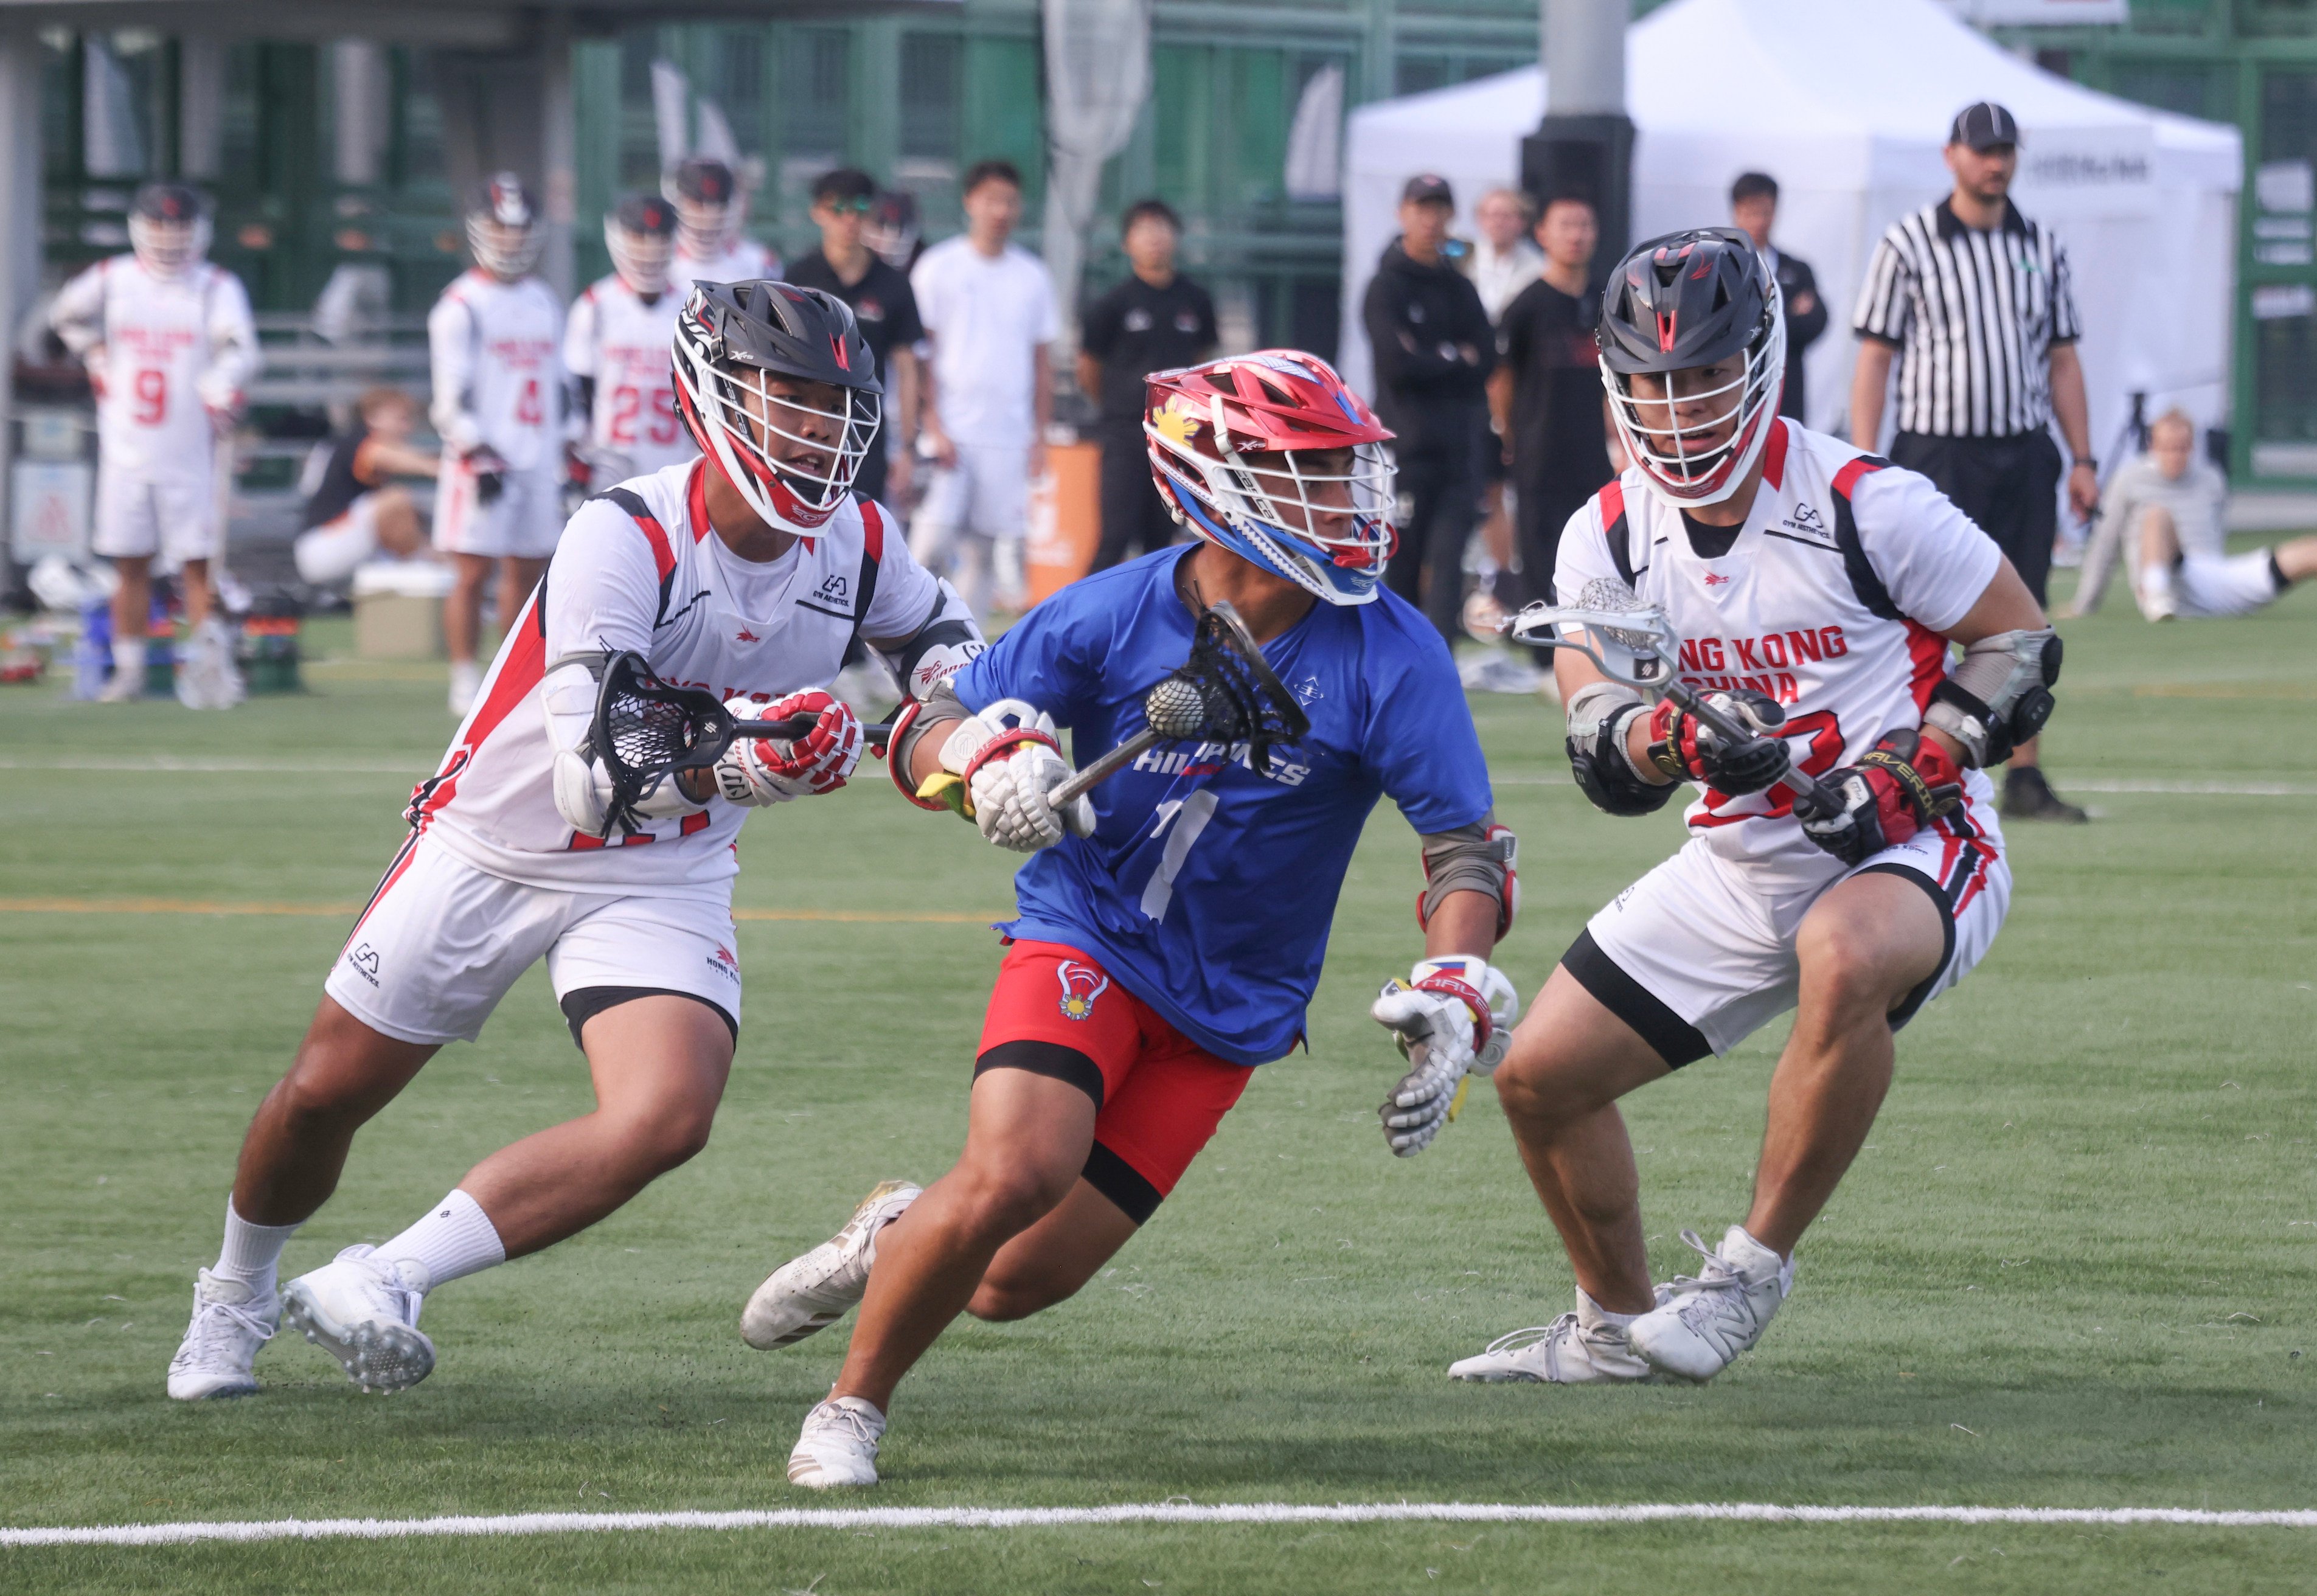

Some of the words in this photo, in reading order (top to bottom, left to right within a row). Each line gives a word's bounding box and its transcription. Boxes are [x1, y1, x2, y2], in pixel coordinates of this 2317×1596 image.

[729, 350, 754, 360] XRS
[133, 369, 167, 428] 9
[514, 377, 543, 427] 4
[610, 385, 680, 446] 25
[1237, 440, 1266, 453] XRS
[1782, 519, 1796, 529] GYM
[1731, 625, 1849, 671] KONG
[1140, 788, 1220, 926] 1
[706, 956, 728, 974] HONG
